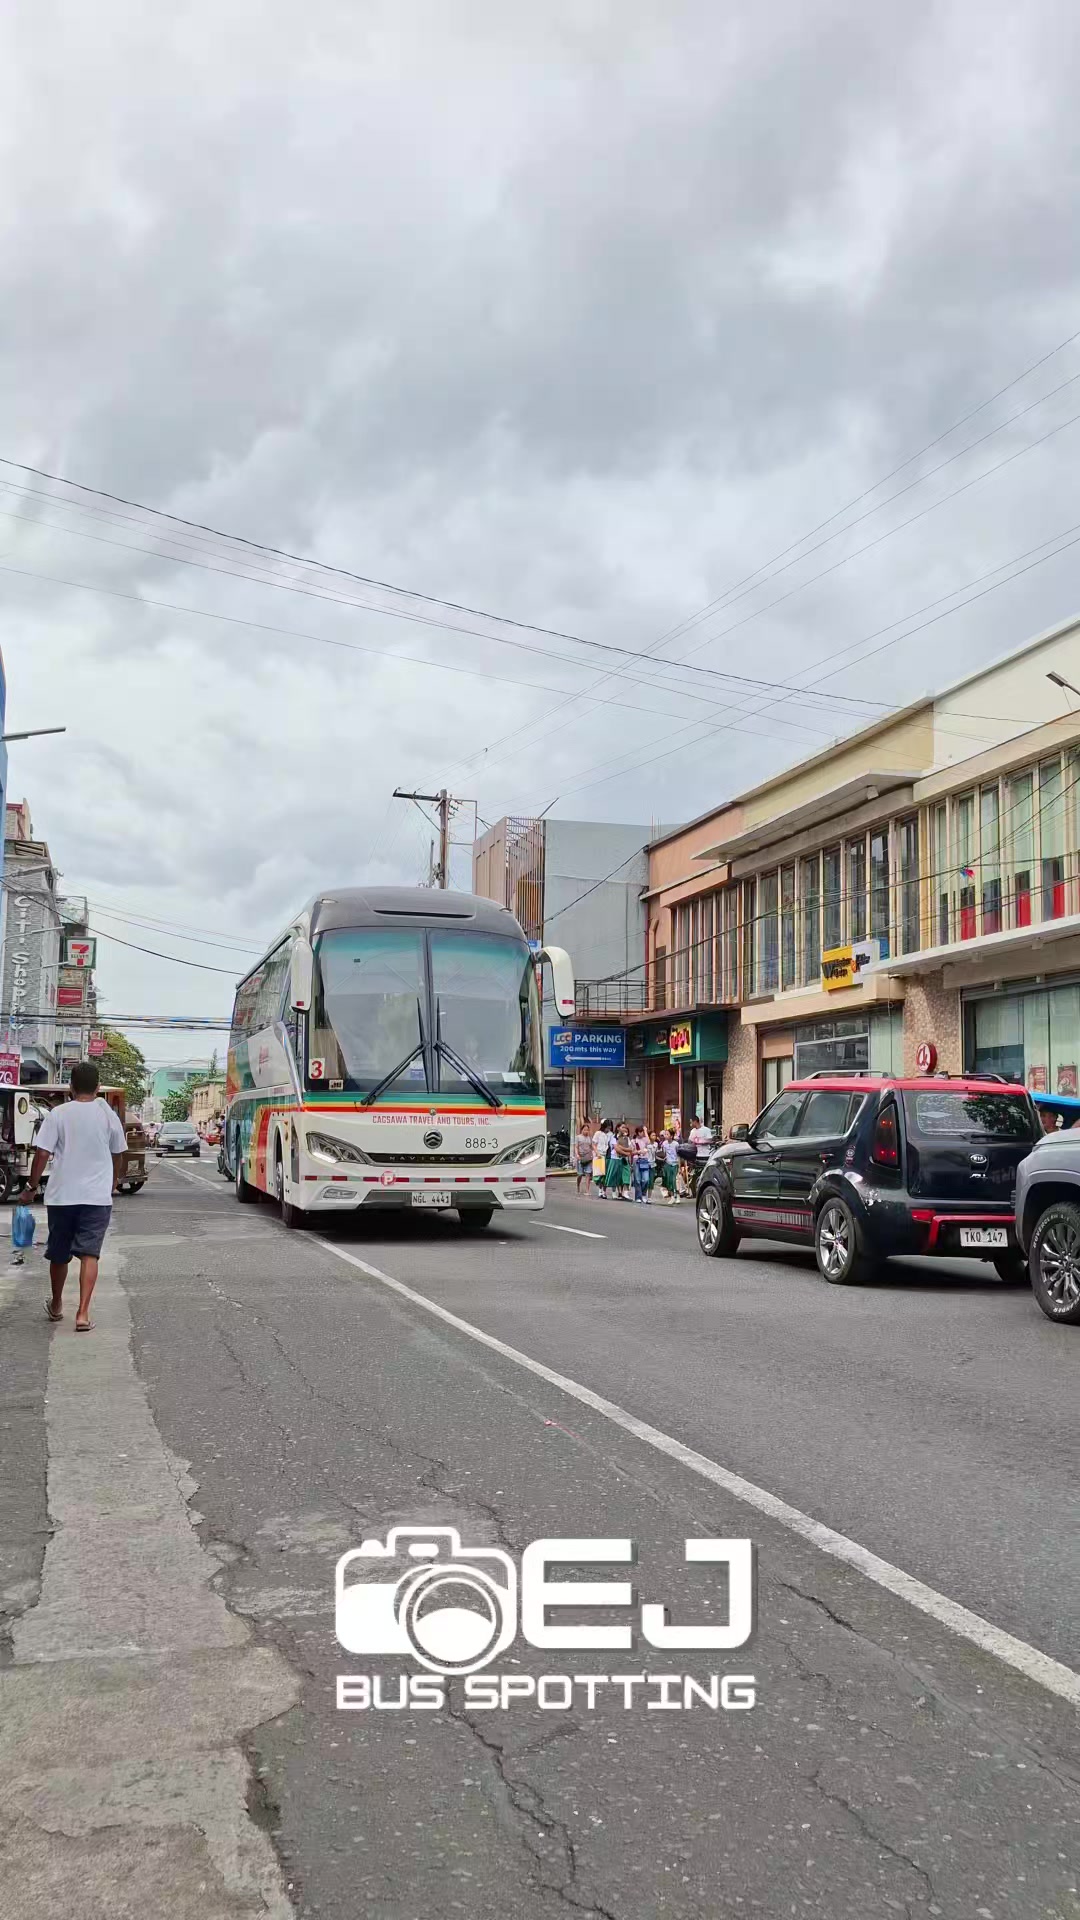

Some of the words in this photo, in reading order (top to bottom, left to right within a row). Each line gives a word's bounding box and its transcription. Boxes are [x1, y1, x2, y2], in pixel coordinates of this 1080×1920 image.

[574, 1034, 622, 1044] PARKING
[589, 1045, 602, 1053] this
[310, 1060, 323, 1079] 3
[372, 1115, 408, 1124] CAGSAWA
[409, 1115, 434, 1125] TRAVEL
[436, 1116, 451, 1125] AND
[452, 1117, 477, 1126] TOURS,
[478, 1117, 491, 1126] INC.
[465, 1137, 499, 1149] 888-3
[412, 1195, 427, 1204] NGL
[431, 1195, 450, 1204] 4441
[987, 1231, 1003, 1243] 147
